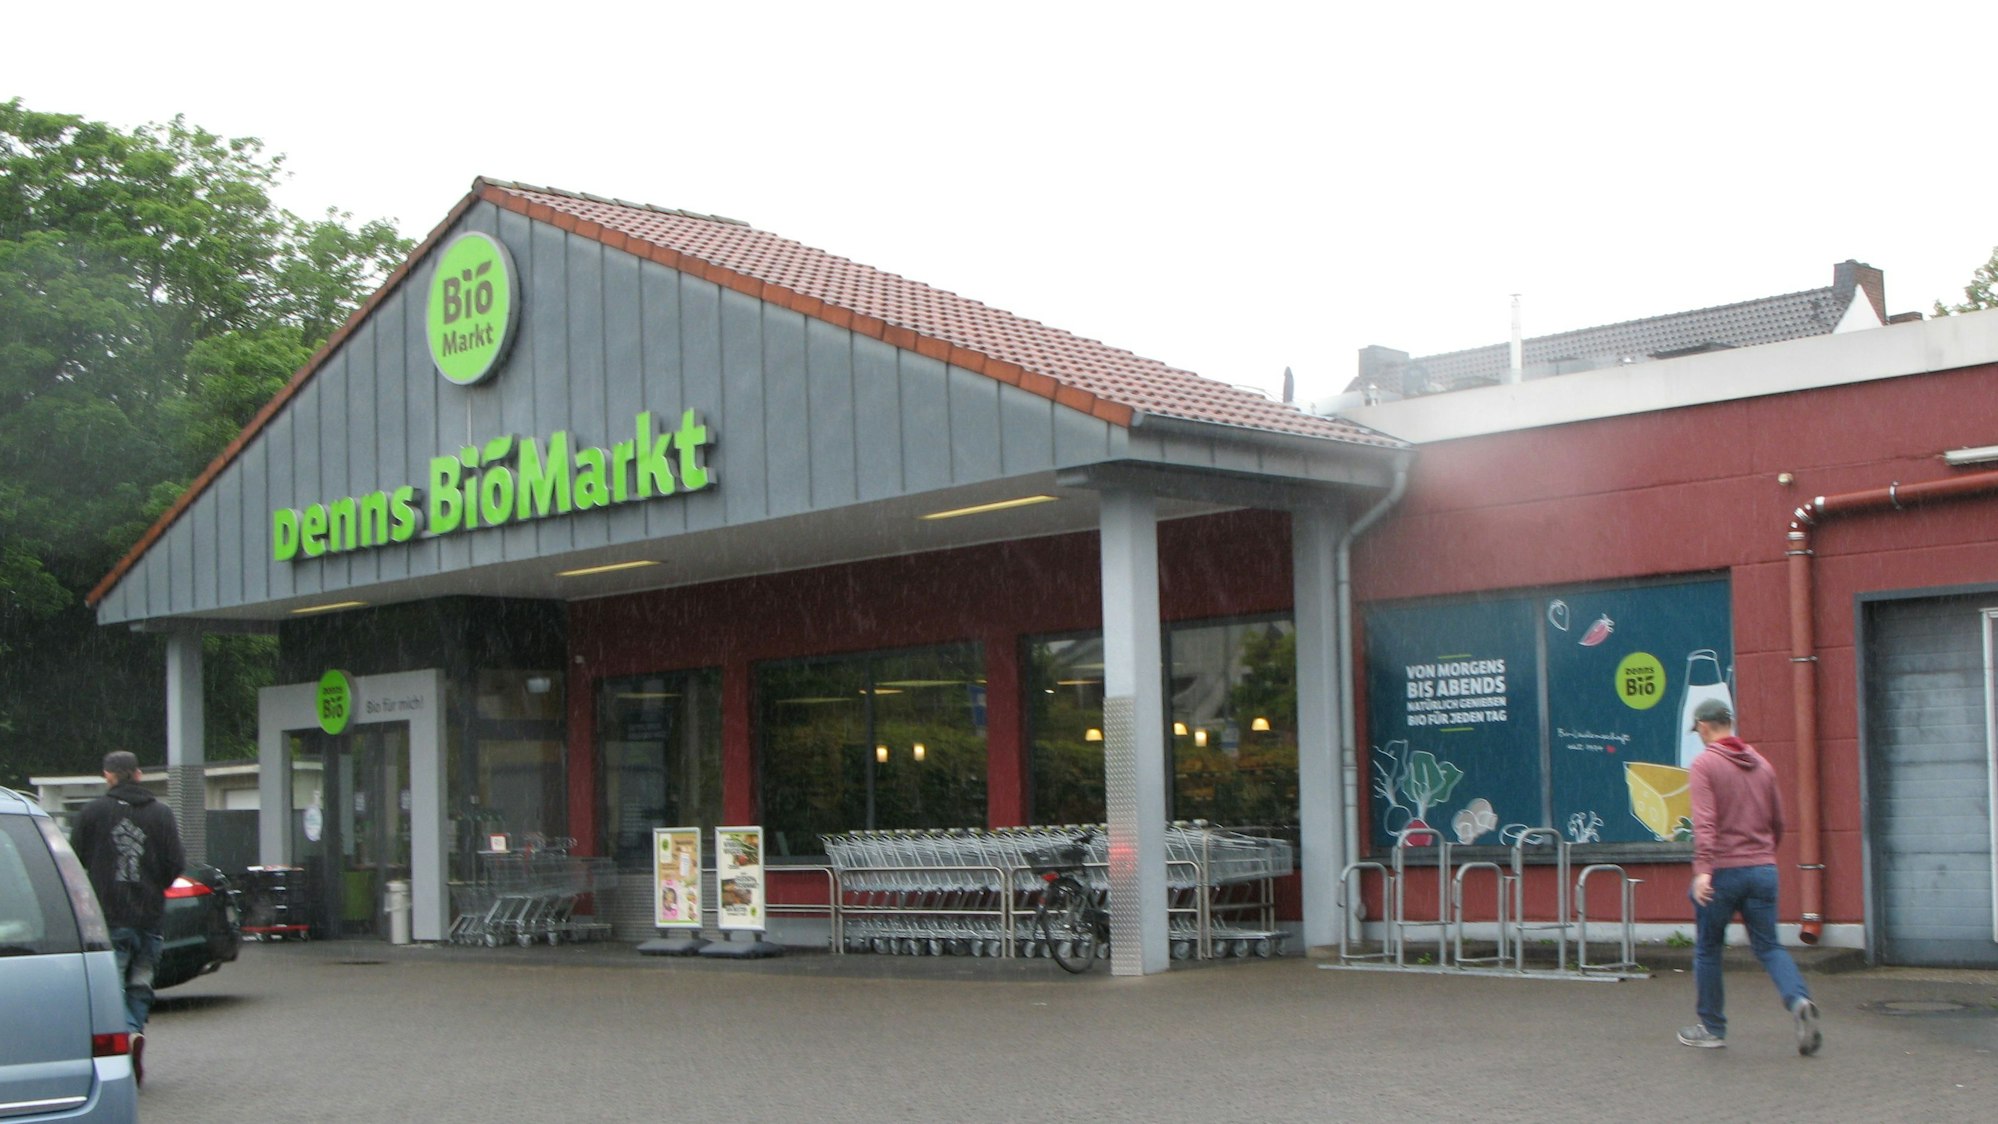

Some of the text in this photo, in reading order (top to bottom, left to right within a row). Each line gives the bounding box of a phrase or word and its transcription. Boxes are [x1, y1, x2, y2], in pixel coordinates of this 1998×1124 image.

[443, 259, 494, 325] Bio
[442, 322, 494, 357] Markt
[273, 407, 711, 561] Denns BioMarkt
[1405, 659, 1506, 679] VON MORGENS
[1406, 676, 1507, 699] BIS ABENDS
[1626, 675, 1655, 696] Bio
[366, 699, 380, 714] Bio
[1406, 698, 1459, 712] NATÜRLICH
[1407, 709, 1508, 726] BIO FÜR JEDEN TAG
